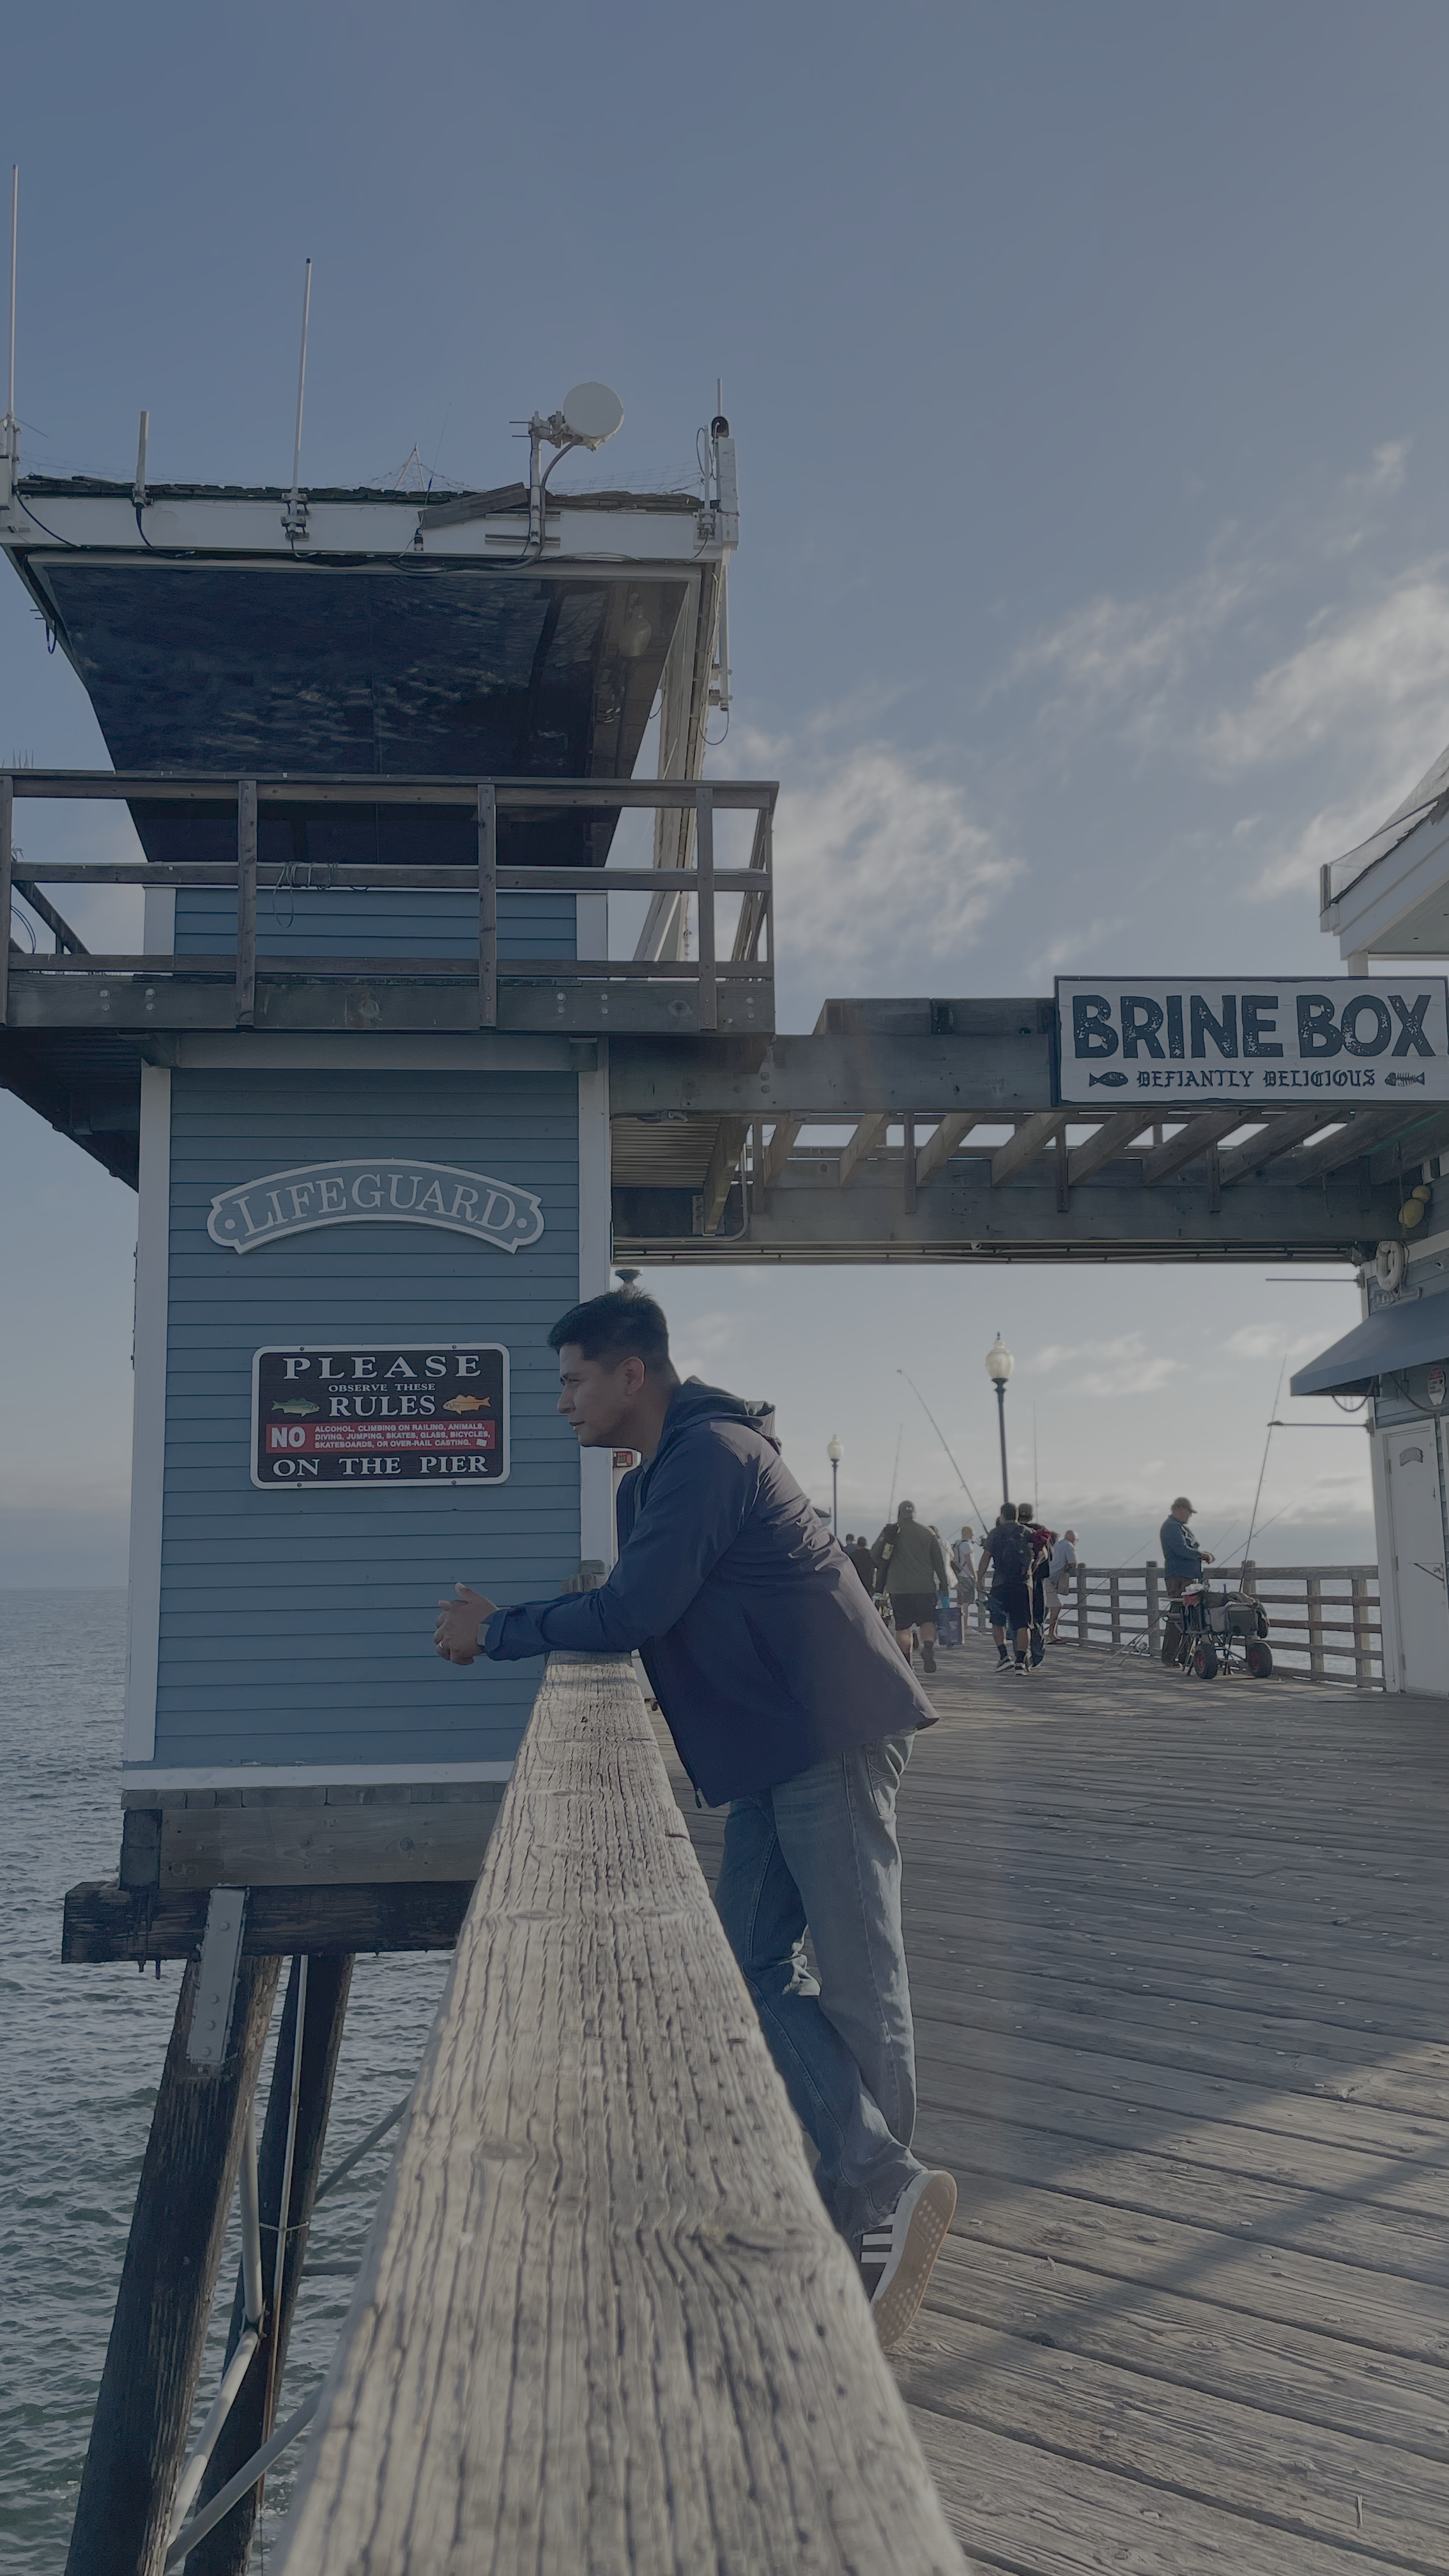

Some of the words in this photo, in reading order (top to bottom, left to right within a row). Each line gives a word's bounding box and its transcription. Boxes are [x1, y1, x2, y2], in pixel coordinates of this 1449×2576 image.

[1072, 995, 1284, 1059] BRINE
[1296, 994, 1436, 1058] BOX
[1137, 1070, 1254, 1087] DEFIANTLY
[1263, 1069, 1375, 1087] DELICIOUS
[233, 1173, 516, 1236] LIFEGUARD
[282, 1355, 481, 1379] PLEASE
[328, 1383, 388, 1392] OBSERVE
[394, 1383, 436, 1392] THESE
[328, 1395, 436, 1417] RULES
[271, 1426, 305, 1448] NO
[272, 1459, 320, 1476] ON
[338, 1457, 401, 1475] THE
[419, 1455, 488, 1473] PIER
